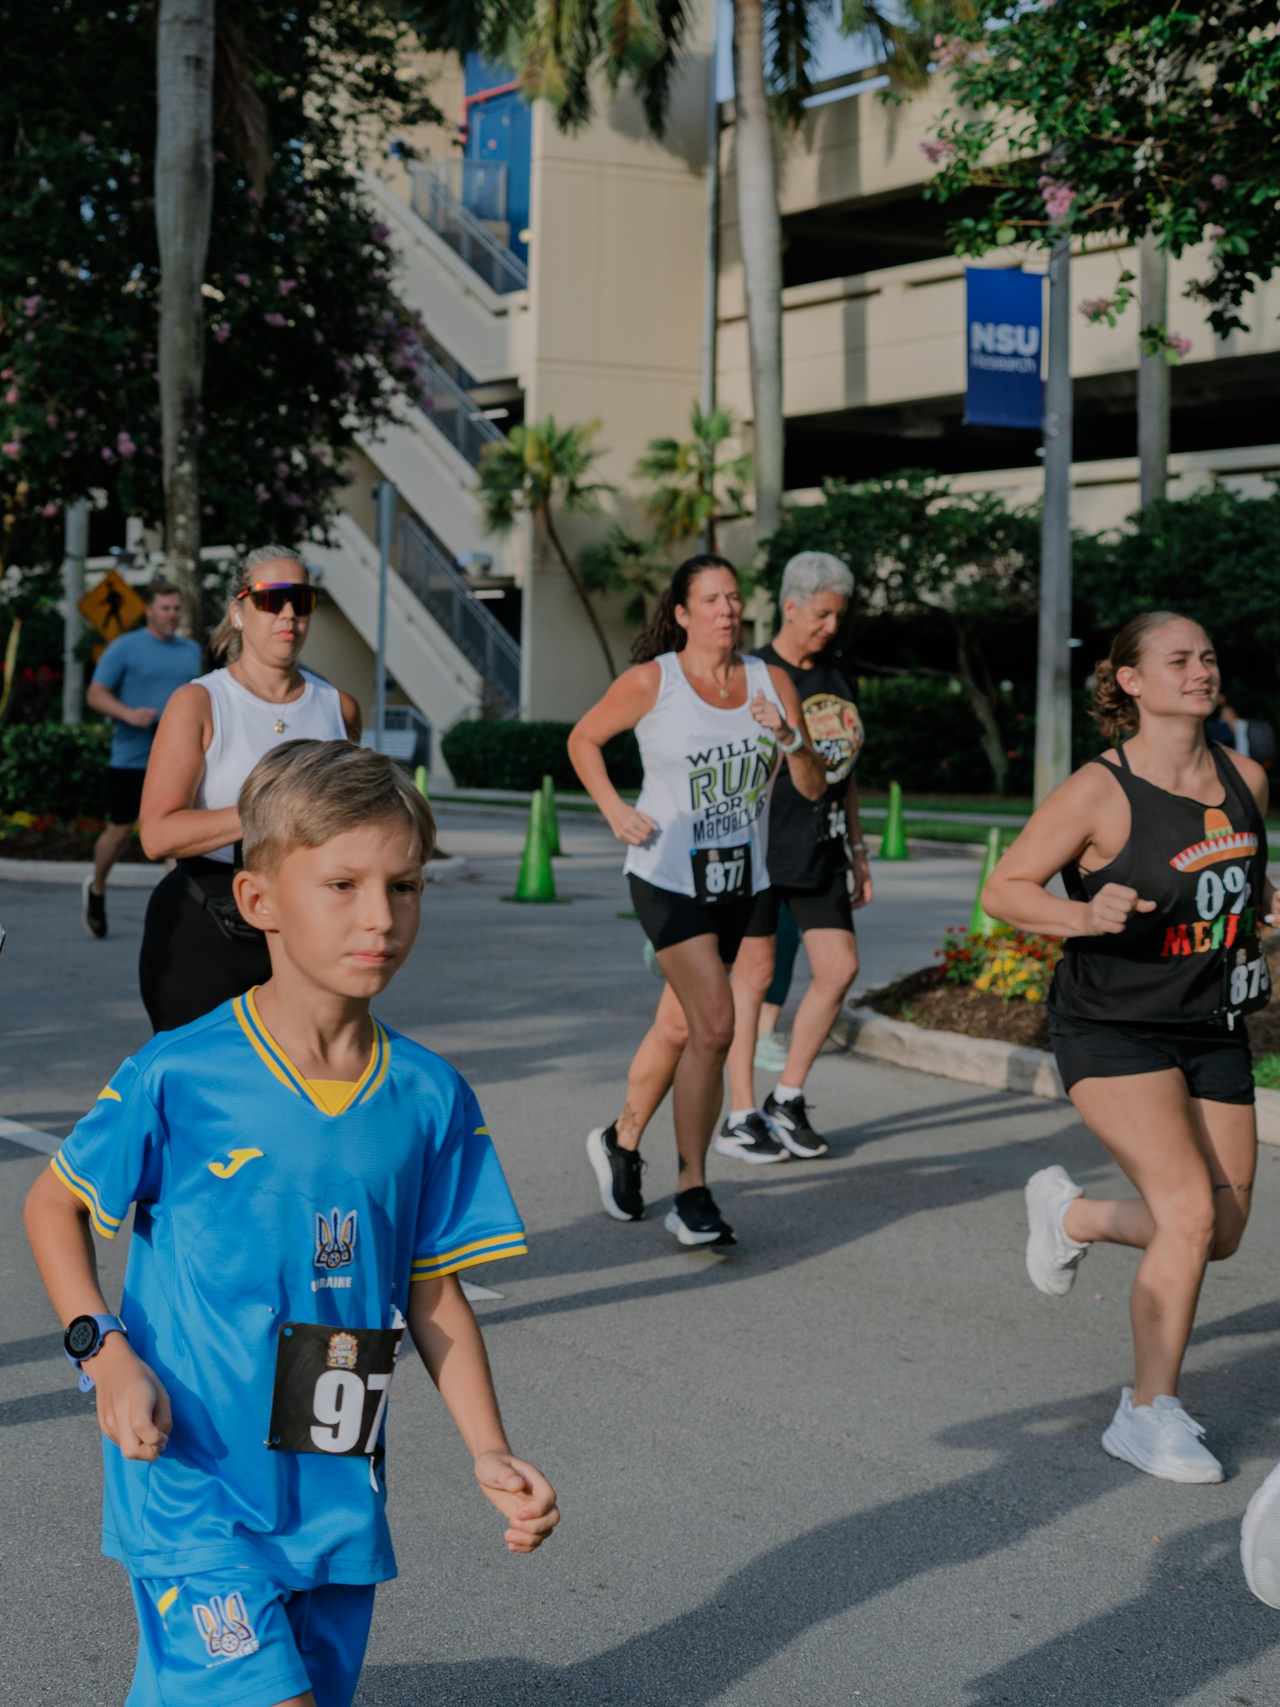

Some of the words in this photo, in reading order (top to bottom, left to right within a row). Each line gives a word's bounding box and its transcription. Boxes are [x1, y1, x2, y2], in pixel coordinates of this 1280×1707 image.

[970, 321, 1040, 357] NSU
[686, 738, 757, 767] WILL
[704, 796, 742, 820] FOR
[705, 858, 745, 894] 877
